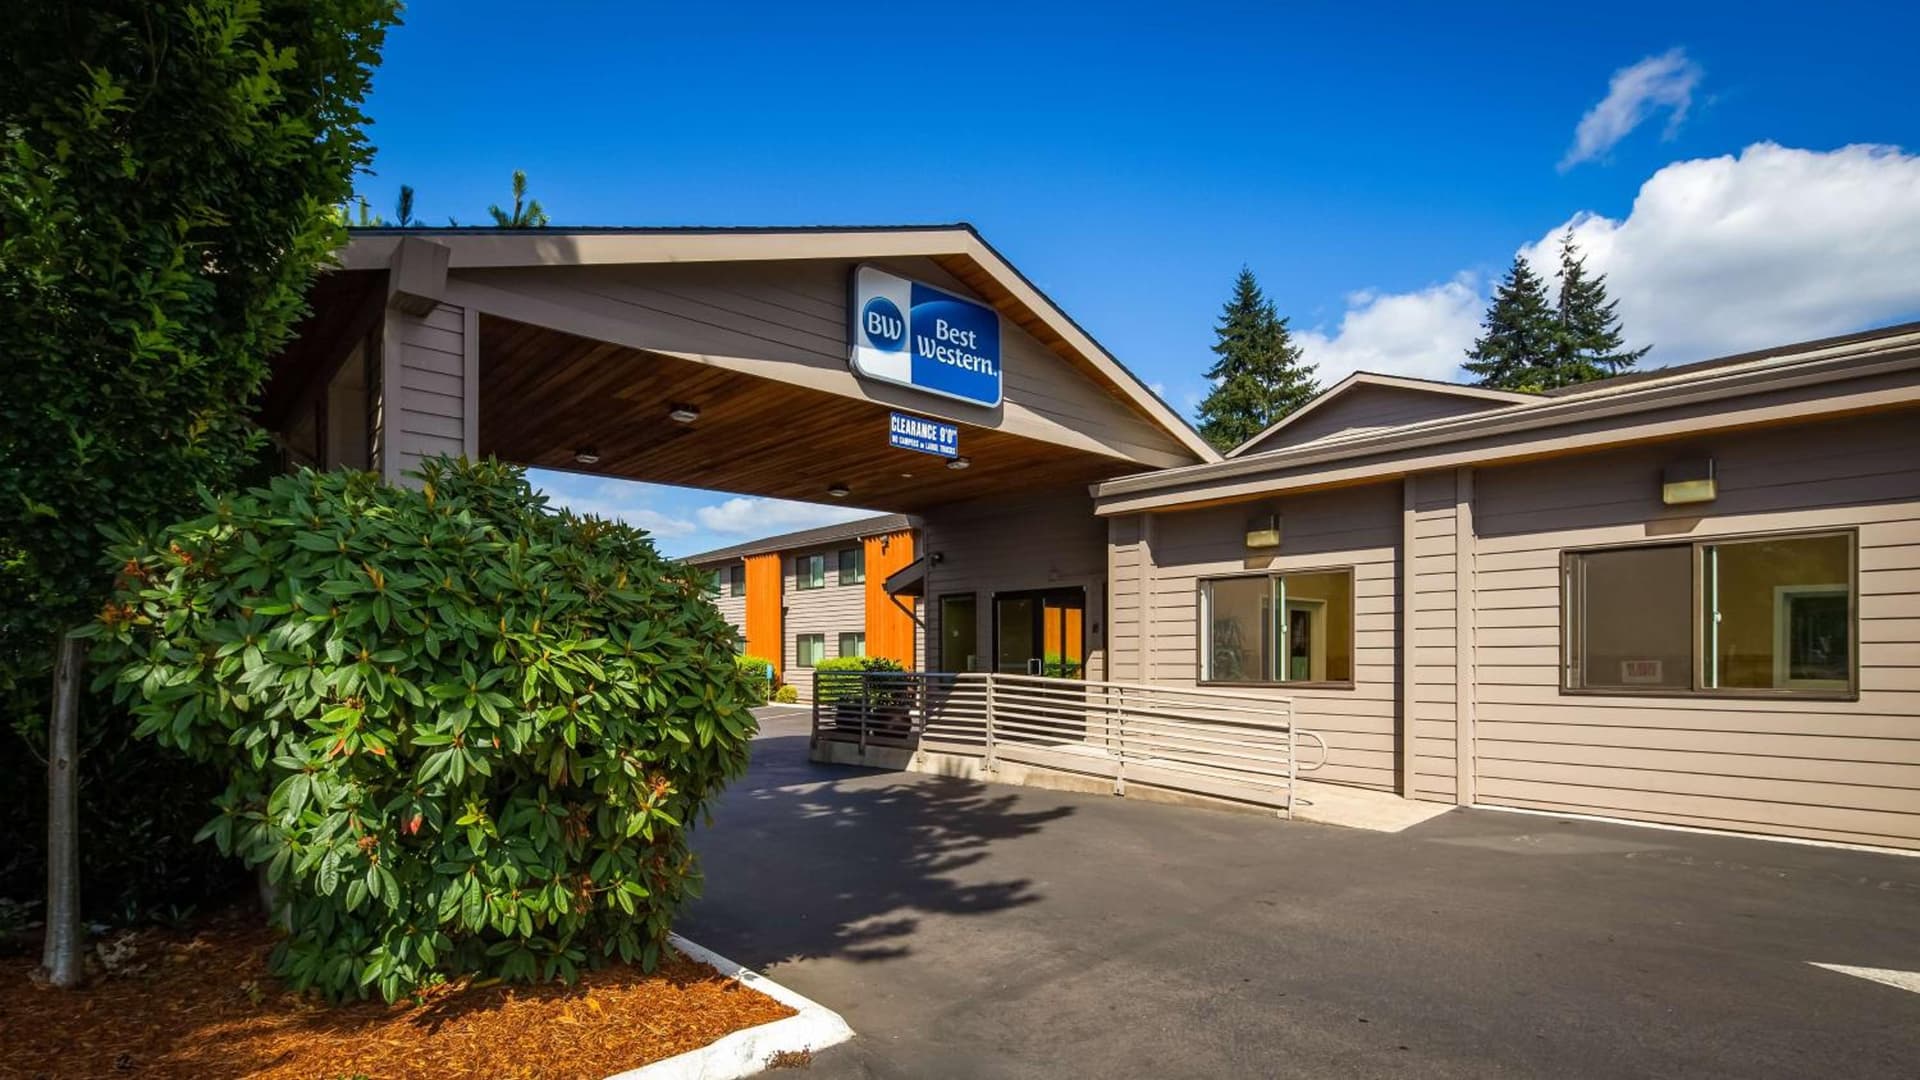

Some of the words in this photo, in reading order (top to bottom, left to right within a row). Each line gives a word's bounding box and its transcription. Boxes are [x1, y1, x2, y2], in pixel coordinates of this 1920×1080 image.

[868, 311, 901, 340] BW
[936, 319, 976, 349] Best
[891, 416, 937, 440] CLEARANCE
